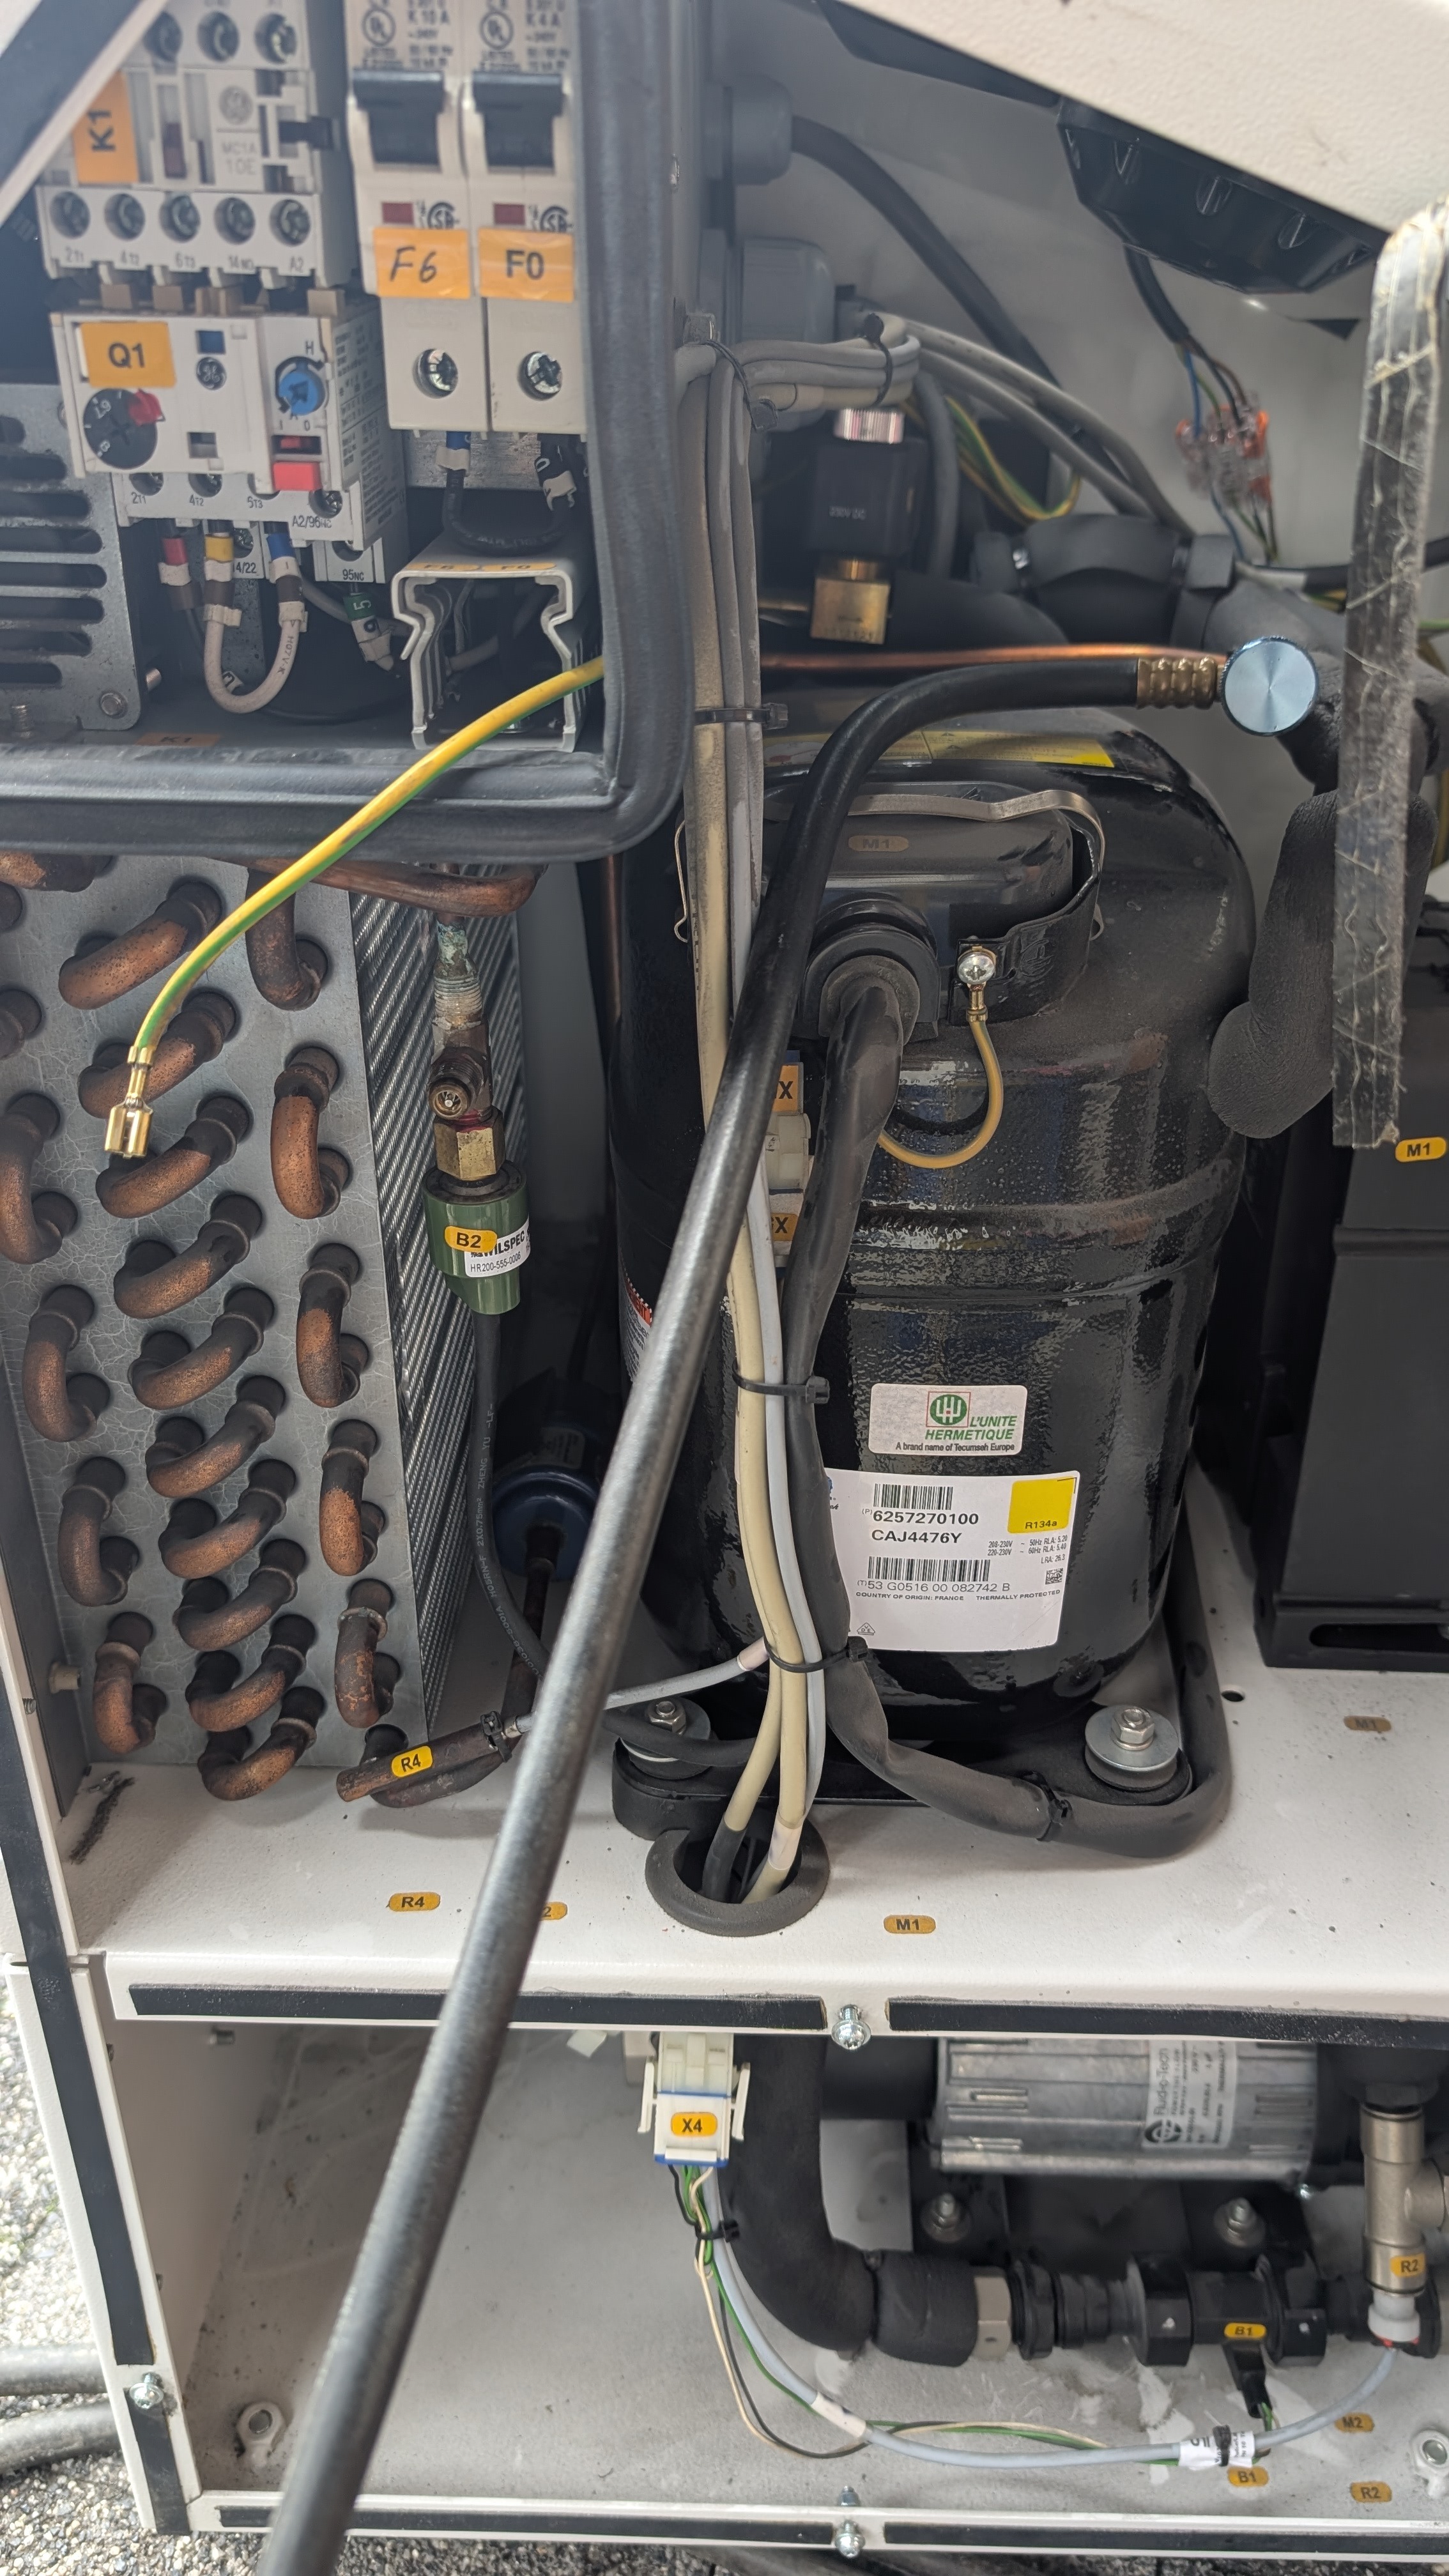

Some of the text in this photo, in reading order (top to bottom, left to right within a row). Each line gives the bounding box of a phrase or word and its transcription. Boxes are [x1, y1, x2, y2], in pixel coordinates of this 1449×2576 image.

[87, 109, 116, 153] K1
[389, 246, 437, 283] F6
[108, 342, 145, 369] Q1
[188, 494, 204, 507] 4T2
[342, 568, 365, 581] 95NC
[862, 838, 892, 850] M1
[1406, 1142, 1430, 1157] M1
[456, 1232, 482, 1248] B2
[925, 1429, 1015, 1441] HERMETIQUE
[481, 1436, 491, 1451] YU
[896, 1442, 901, 1450] A
[903, 1442, 923, 1451] brand
[954, 1443, 989, 1452] Tecumseh
[990, 1443, 1015, 1452] Europe
[477, 1457, 489, 1489] ZHENG
[1025, 1520, 1057, 1529] R134a
[871, 1529, 962, 1544] CAJ4476Y
[932, 1583, 948, 1592] 00
[951, 1583, 997, 1593] 082742
[1002, 1583, 1011, 1591] B
[1019, 1589, 1061, 1600] PROTECTED
[1354, 1719, 1377, 1729] M1
[401, 1753, 423, 1774] R4
[401, 1896, 425, 1908] R4
[895, 1918, 921, 1931] M1
[681, 2117, 703, 2134] X4
[1400, 2259, 1419, 2273] R2
[1234, 2326, 1253, 2336] B1
[1342, 2416, 1363, 2428] M2
[1238, 2471, 1257, 2483] B1
[1360, 2487, 1381, 2499] R2
